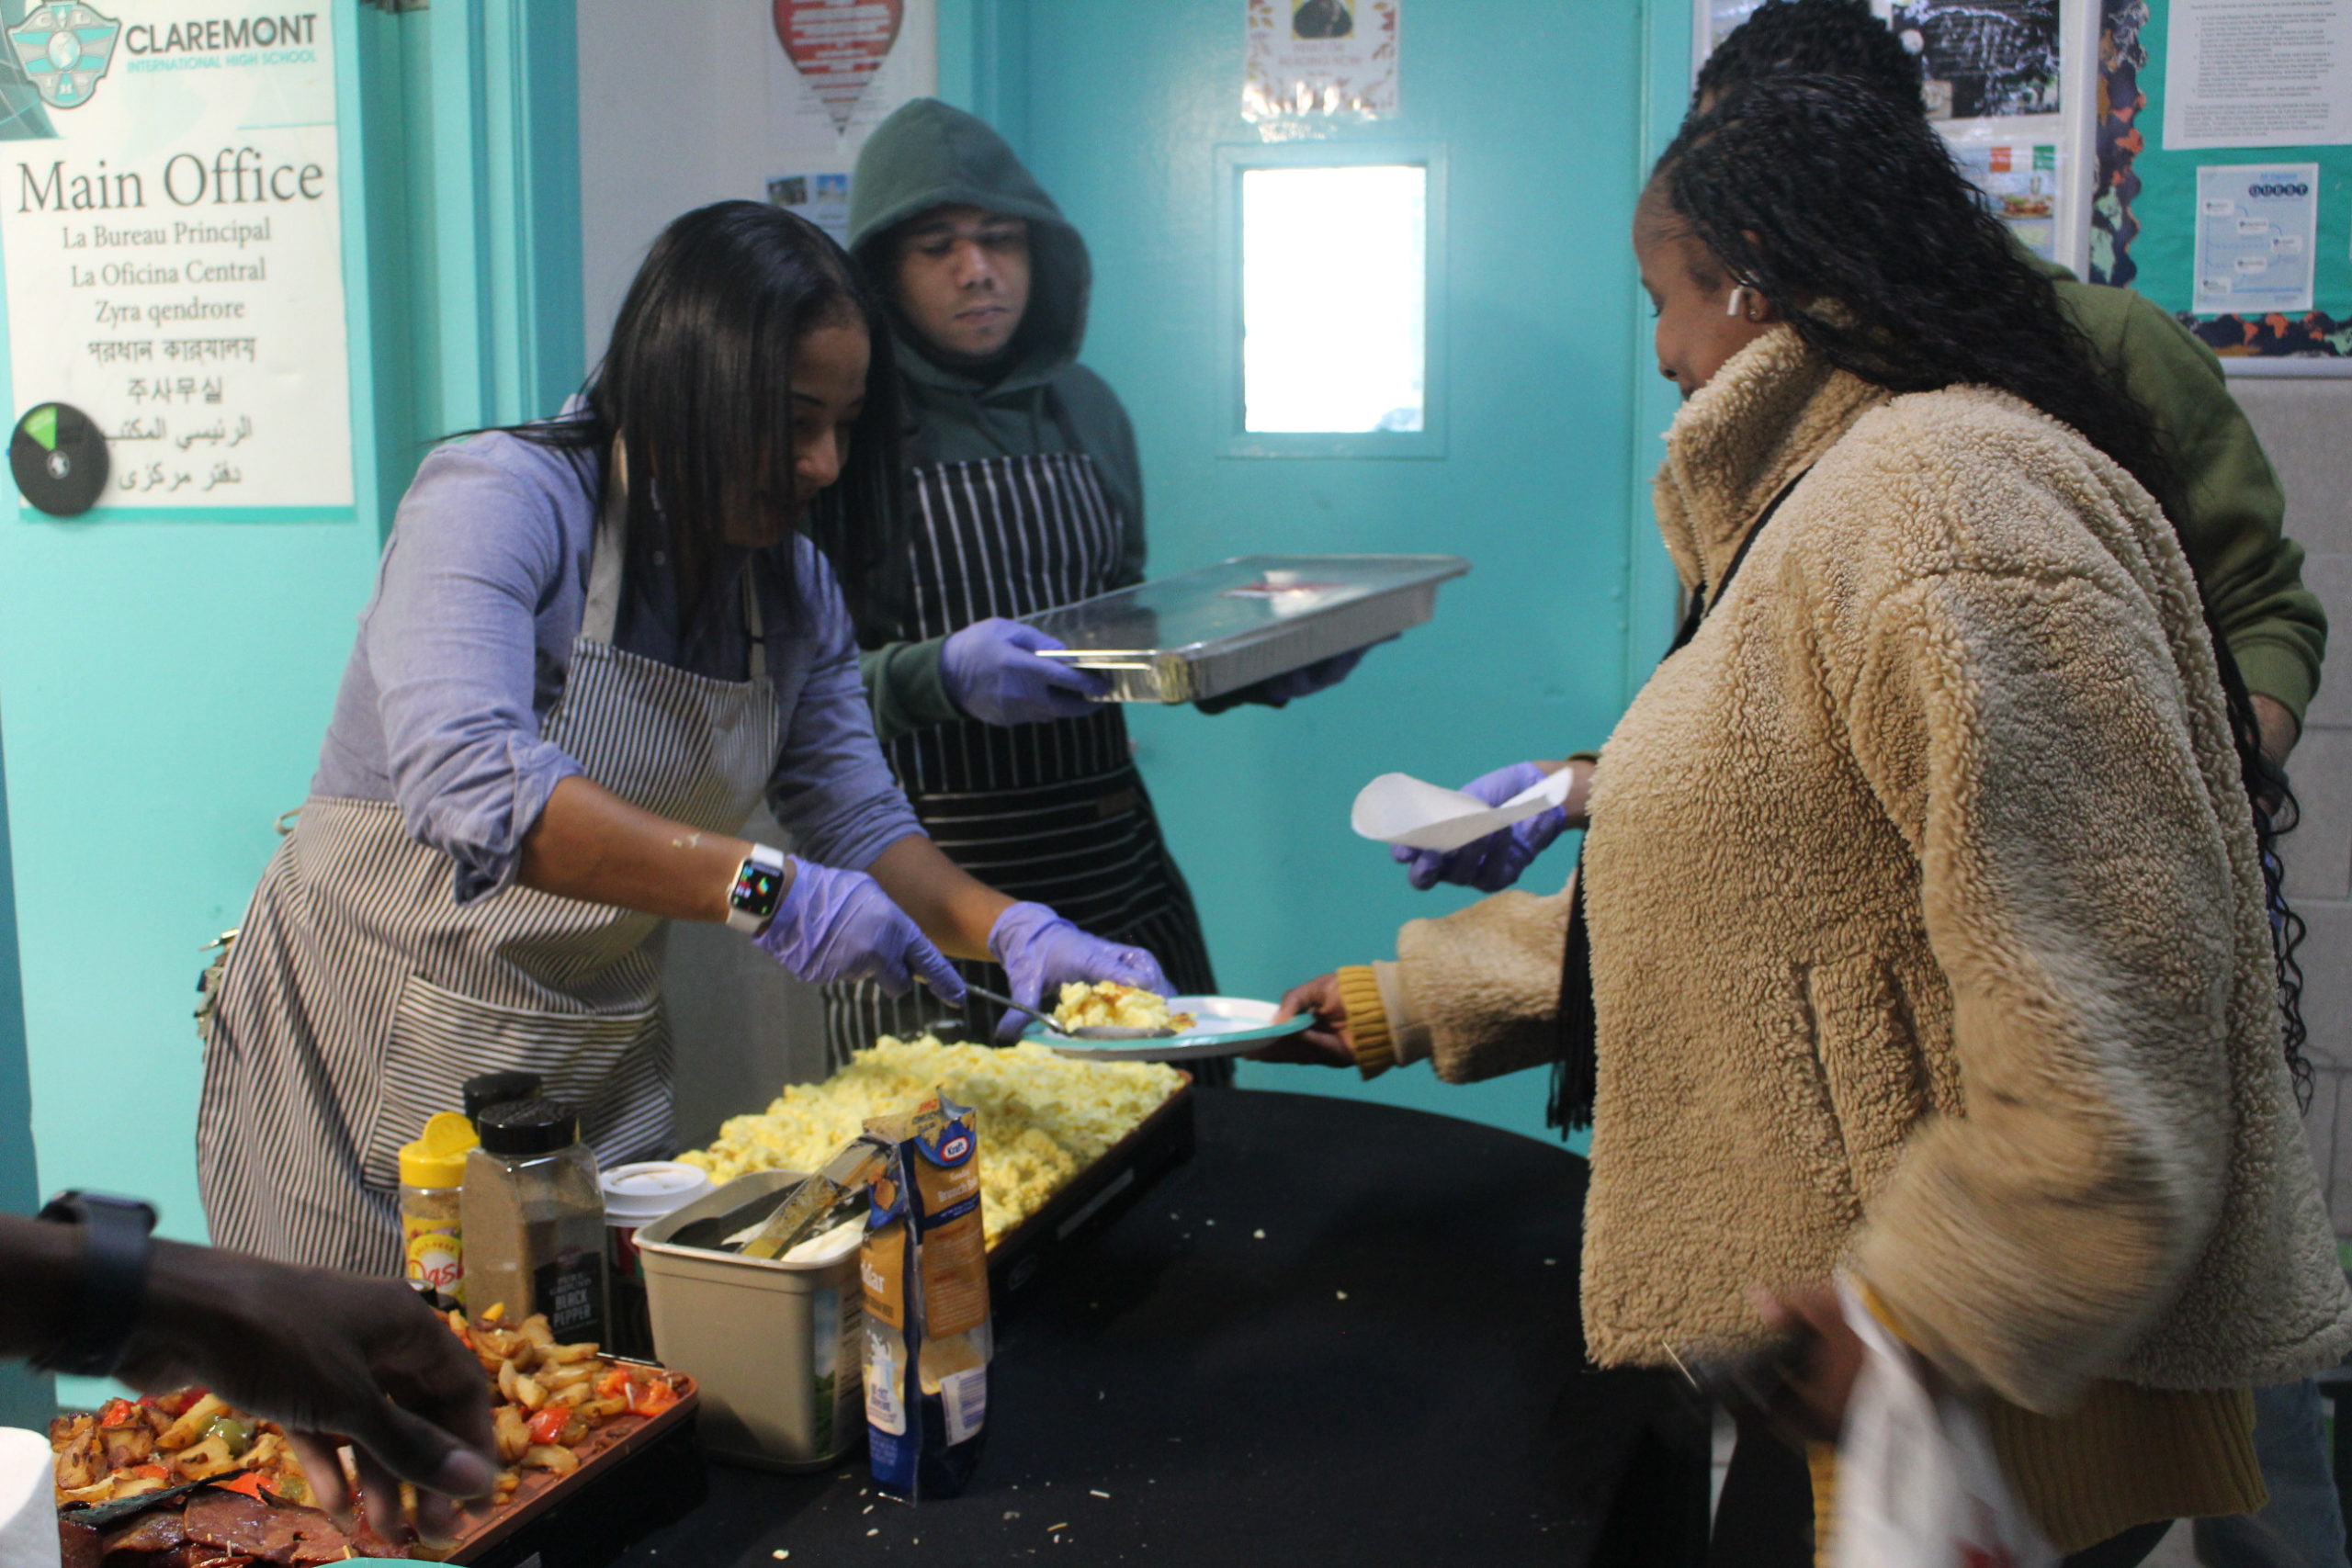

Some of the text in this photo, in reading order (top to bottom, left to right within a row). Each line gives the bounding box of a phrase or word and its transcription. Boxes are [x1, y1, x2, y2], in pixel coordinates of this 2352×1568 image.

[126, 14, 317, 55] CLAREMONT
[127, 49, 316, 73] INTERNATIONAL HIGH SCHOOL
[17, 147, 324, 212] Main Office
[63, 217, 270, 249] La Bureau Principal
[71, 256, 266, 288] La Oficina Central
[96, 296, 245, 330] Zyra qendrore
[127, 376, 223, 404] 주사무실
[553, 1303, 592, 1328] PEPPER
[555, 1288, 588, 1311] BLACK
